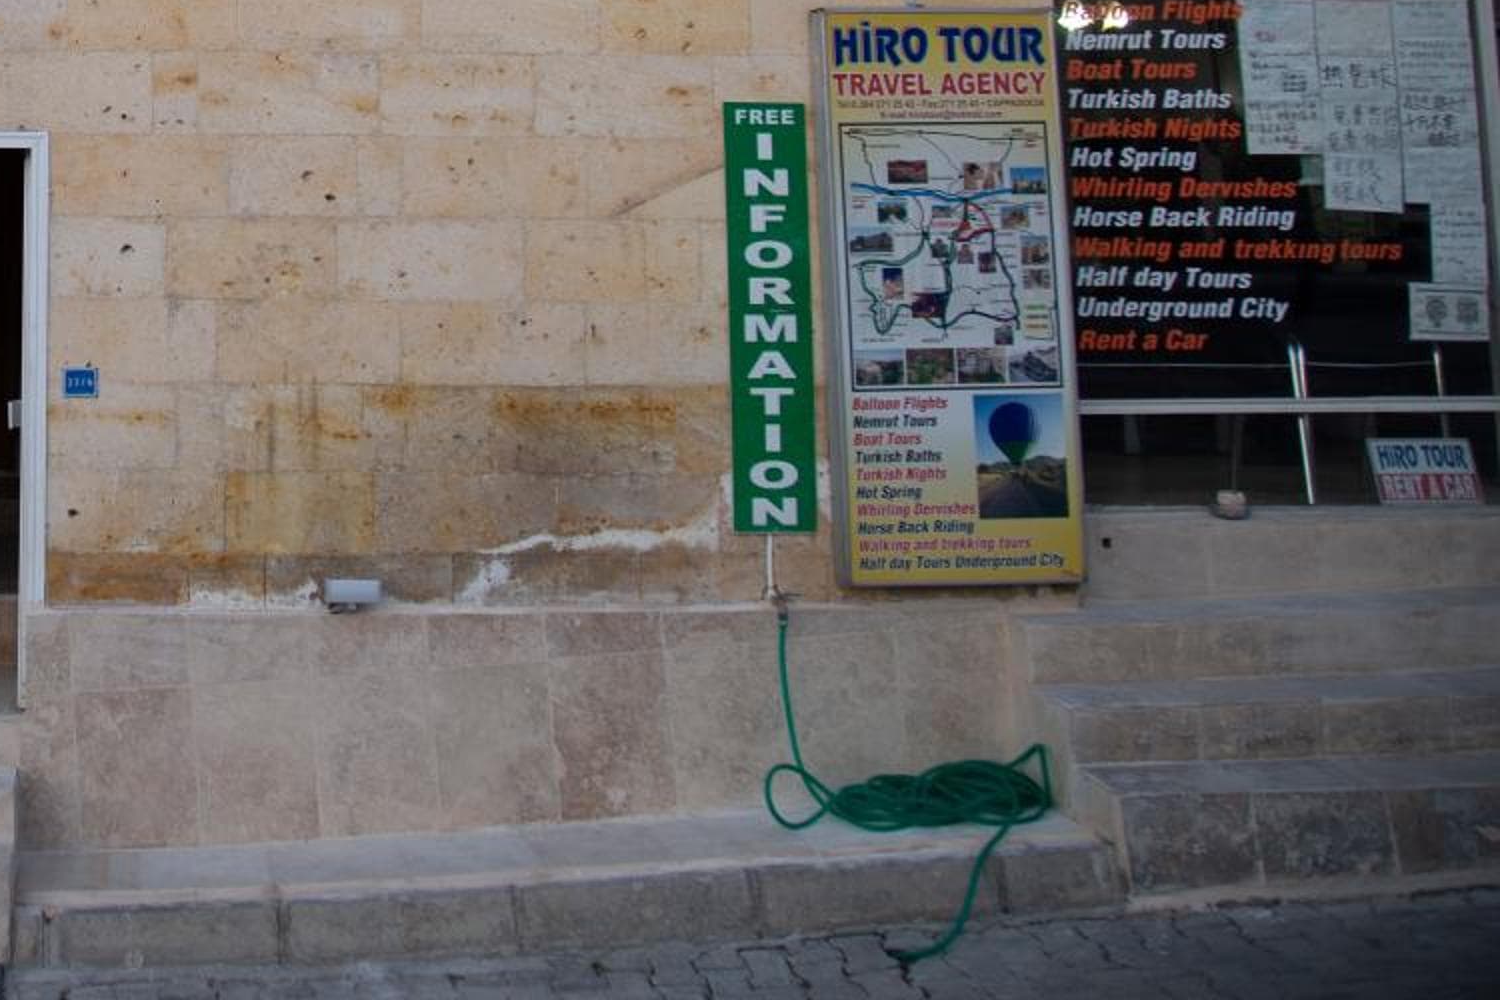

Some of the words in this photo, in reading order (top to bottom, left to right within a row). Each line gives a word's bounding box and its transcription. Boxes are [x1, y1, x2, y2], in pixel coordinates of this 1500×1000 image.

[1163, 0, 1244, 24] Flights
[939, 26, 1045, 65] TOUR
[1065, 29, 1153, 50] Nemrut
[1160, 29, 1227, 49] Tours
[1067, 59, 1123, 80] Boat
[1131, 59, 1197, 79] Tours
[833, 73, 932, 96] TRAVEL
[941, 71, 1045, 94] AGENCY
[1068, 88, 1156, 109] Turkish
[1162, 88, 1232, 109] Baths
[735, 110, 794, 124] FREE
[1069, 118, 1157, 138] Turkish
[1164, 117, 1241, 140] Nights
[1071, 147, 1113, 167] Hot
[1119, 147, 1196, 171] Spring
[1073, 177, 1172, 201] Whirling
[1179, 177, 1297, 198] Dervishes
[1073, 207, 1143, 227] Horse
[1150, 207, 1211, 227] Back
[1217, 207, 1295, 231] Riding
[1075, 237, 1172, 261] Walking
[1179, 238, 1223, 259] and
[1235, 238, 1334, 262] trekking
[1340, 240, 1402, 261] tours
[1077, 267, 1128, 287] Half
[1133, 268, 1177, 290] day
[1185, 268, 1252, 289] Tours
[1078, 298, 1232, 322] Underground
[1239, 298, 1289, 322] City
[743, 133, 799, 526] INFORMATION
[1080, 330, 1137, 350] Rent
[1143, 335, 1157, 350] a
[1165, 330, 1208, 350] Car
[852, 397, 900, 410] Balloon
[903, 396, 948, 412] Flights
[853, 416, 899, 428] Nemrut
[903, 415, 937, 427] Tours
[888, 432, 922, 445] Tours
[856, 451, 901, 464] Turkish
[1420, 445, 1469, 470] TOUR
[856, 469, 901, 481] Turkish
[905, 467, 947, 482] Nights
[856, 486, 878, 499] Hot
[881, 485, 922, 500] Spring
[857, 503, 910, 518] Whirling
[858, 520, 893, 534] Horse
[897, 520, 929, 533] Back
[933, 519, 974, 535] Riding
[859, 538, 910, 553] Walking
[913, 538, 937, 551] and
[889, 557, 911, 571] day
[917, 555, 950, 569] Tours
[955, 553, 1036, 569] Underground
[1040, 552, 1065, 567] City
